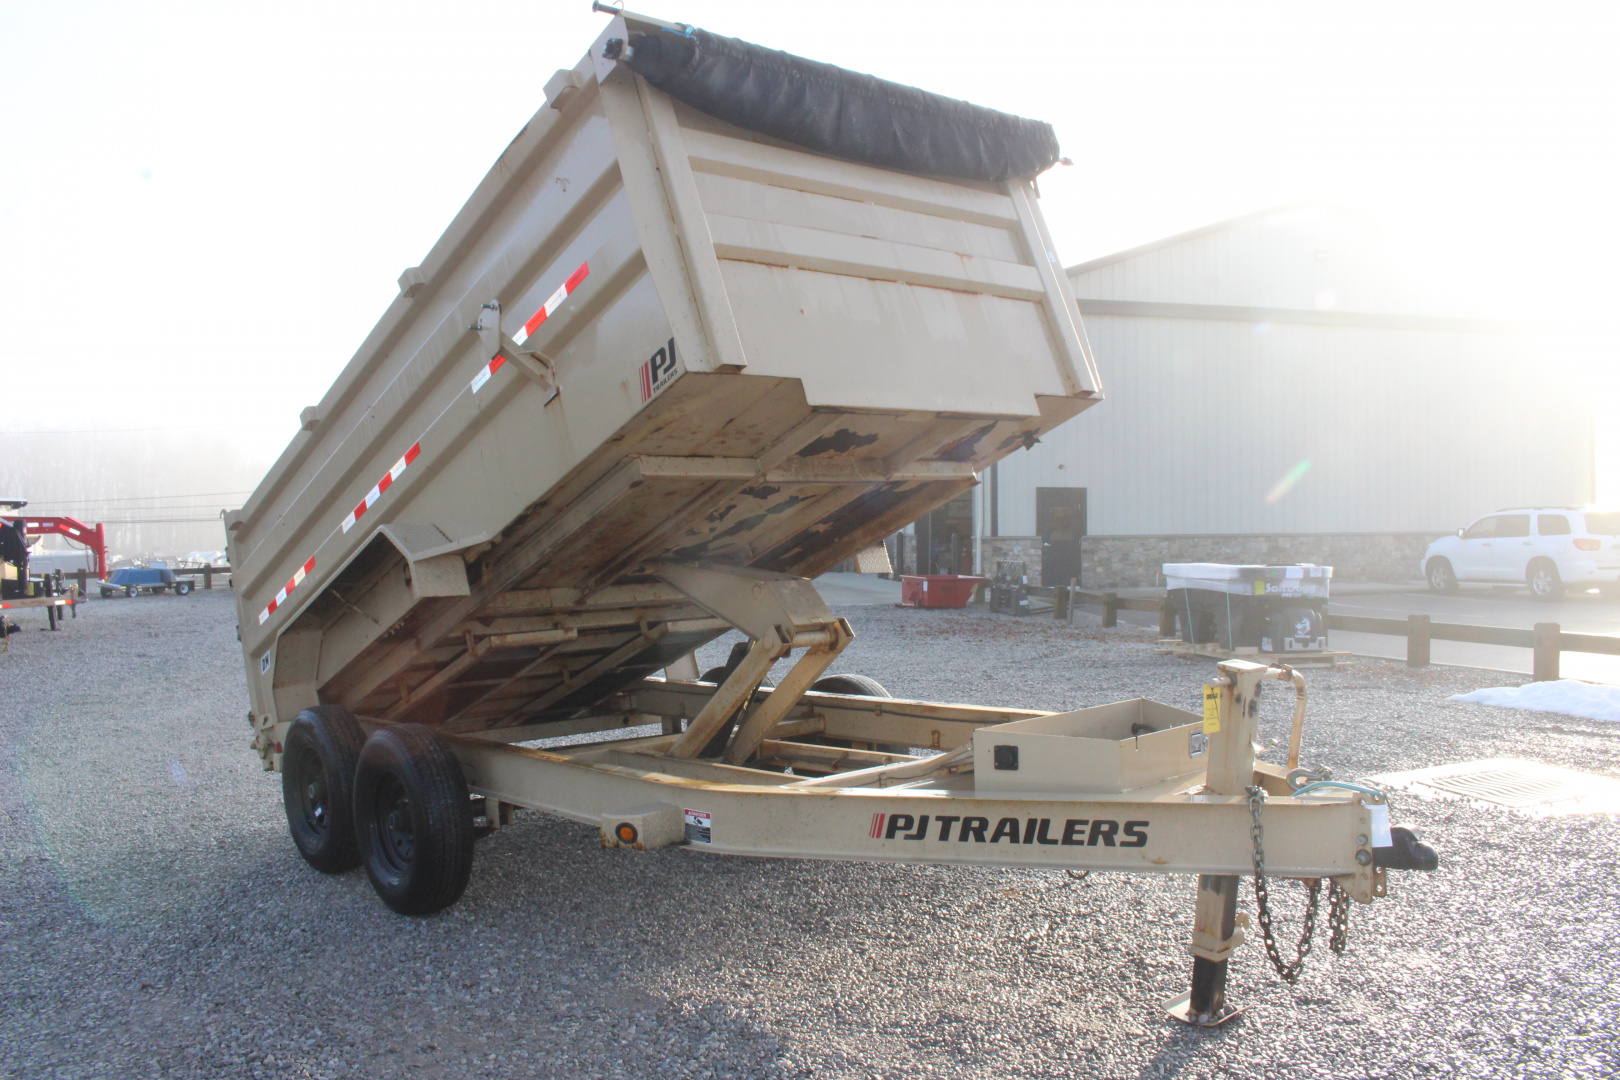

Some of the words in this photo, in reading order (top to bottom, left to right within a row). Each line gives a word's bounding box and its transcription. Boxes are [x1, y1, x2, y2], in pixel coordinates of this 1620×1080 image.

[650, 336, 677, 386] PJ
[652, 367, 678, 394] TRAILERS
[884, 813, 930, 841] PJ
[934, 815, 1150, 848] TRAILERS
